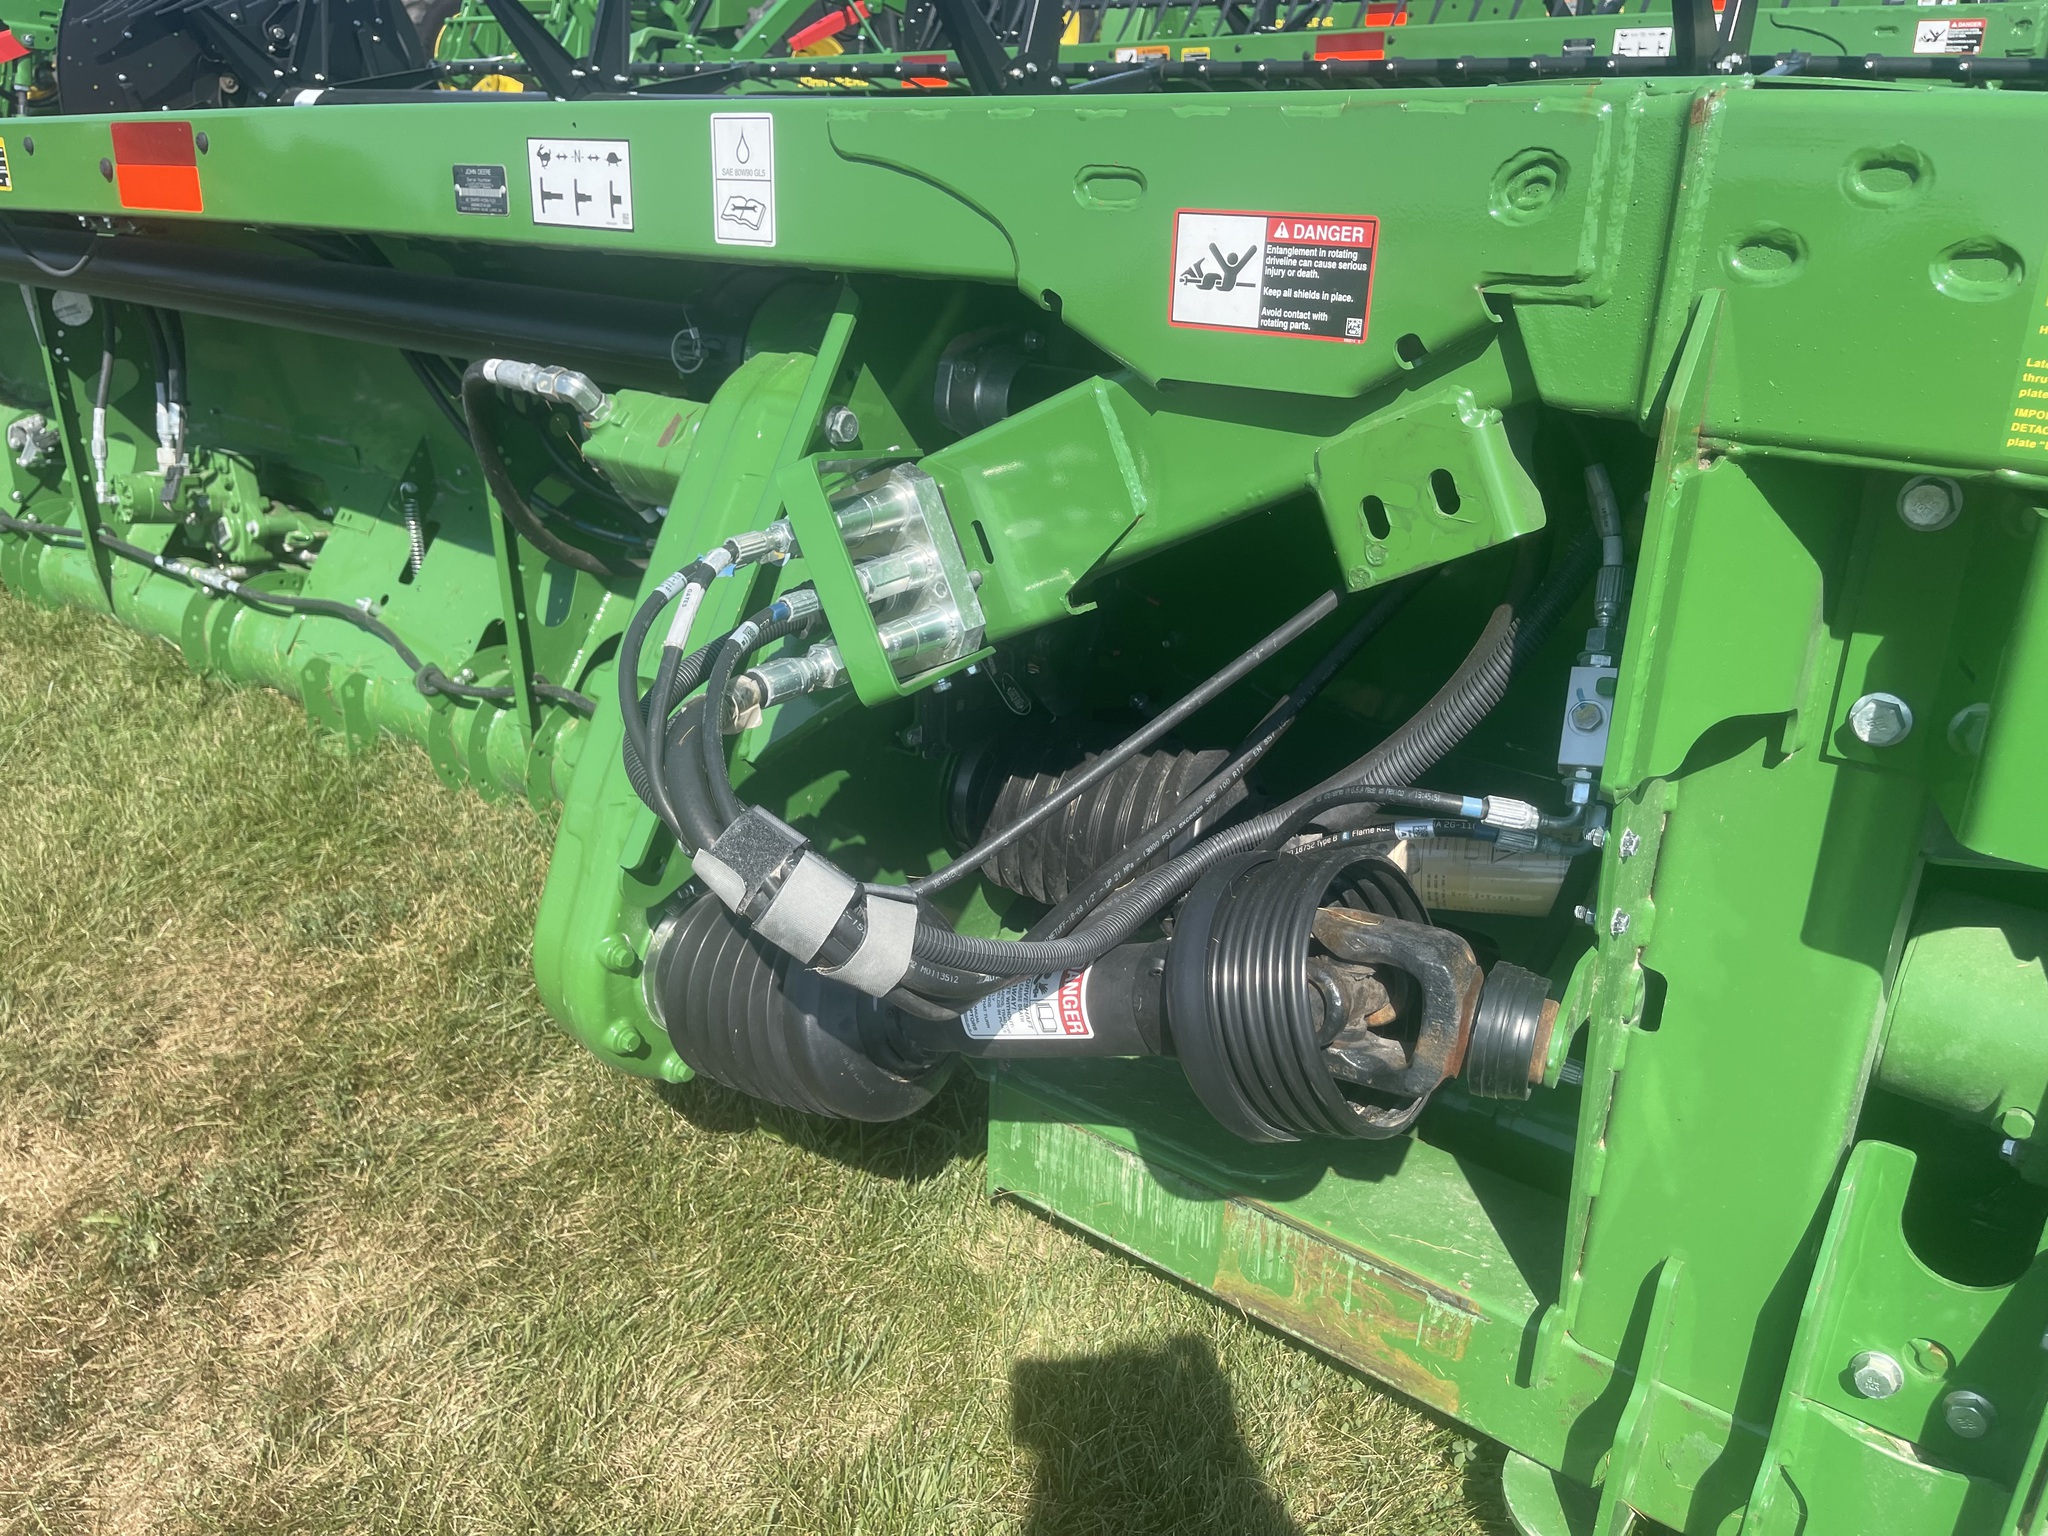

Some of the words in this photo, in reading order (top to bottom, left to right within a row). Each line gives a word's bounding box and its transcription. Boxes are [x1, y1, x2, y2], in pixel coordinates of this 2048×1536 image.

[722, 168, 733, 176] SAE
[755, 169, 765, 177] GL5
[1294, 224, 1364, 242] DANGER
[1266, 244, 1318, 257] Entanglement
[1319, 247, 1326, 256] in
[1328, 248, 1358, 260] rotating
[1266, 256, 1298, 266] driveline
[1299, 260, 1312, 268] can
[1314, 260, 1336, 269] cause
[1338, 262, 1367, 271] serious
[1264, 268, 1286, 279] injury
[1297, 268, 1320, 279] death.
[1263, 287, 1282, 298] Keep
[1283, 288, 1292, 298] all
[1294, 290, 1320, 300] shields
[1322, 292, 1329, 300] in
[1330, 292, 1354, 304] place.
[1262, 307, 1280, 318] Avoid
[1282, 309, 1310, 320] contact
[1312, 311, 1328, 322] with
[1260, 318, 1288, 330] rotating
[1290, 322, 1310, 332] parts.
[2007, 438, 2036, 449] plate
[682, 588, 692, 608] GATES
[1143, 841, 1160, 858] (3000
[1161, 828, 1176, 843] PSI)
[1178, 805, 1204, 830] exceeds
[1204, 792, 1217, 805] SAE
[1219, 778, 1231, 792] 100
[1231, 763, 1245, 778] R17
[1252, 746, 1263, 757] EN
[1333, 834, 1338, 842] B
[1352, 827, 1375, 837] Flame
[1023, 978, 1034, 1029] DRIVESHAFT
